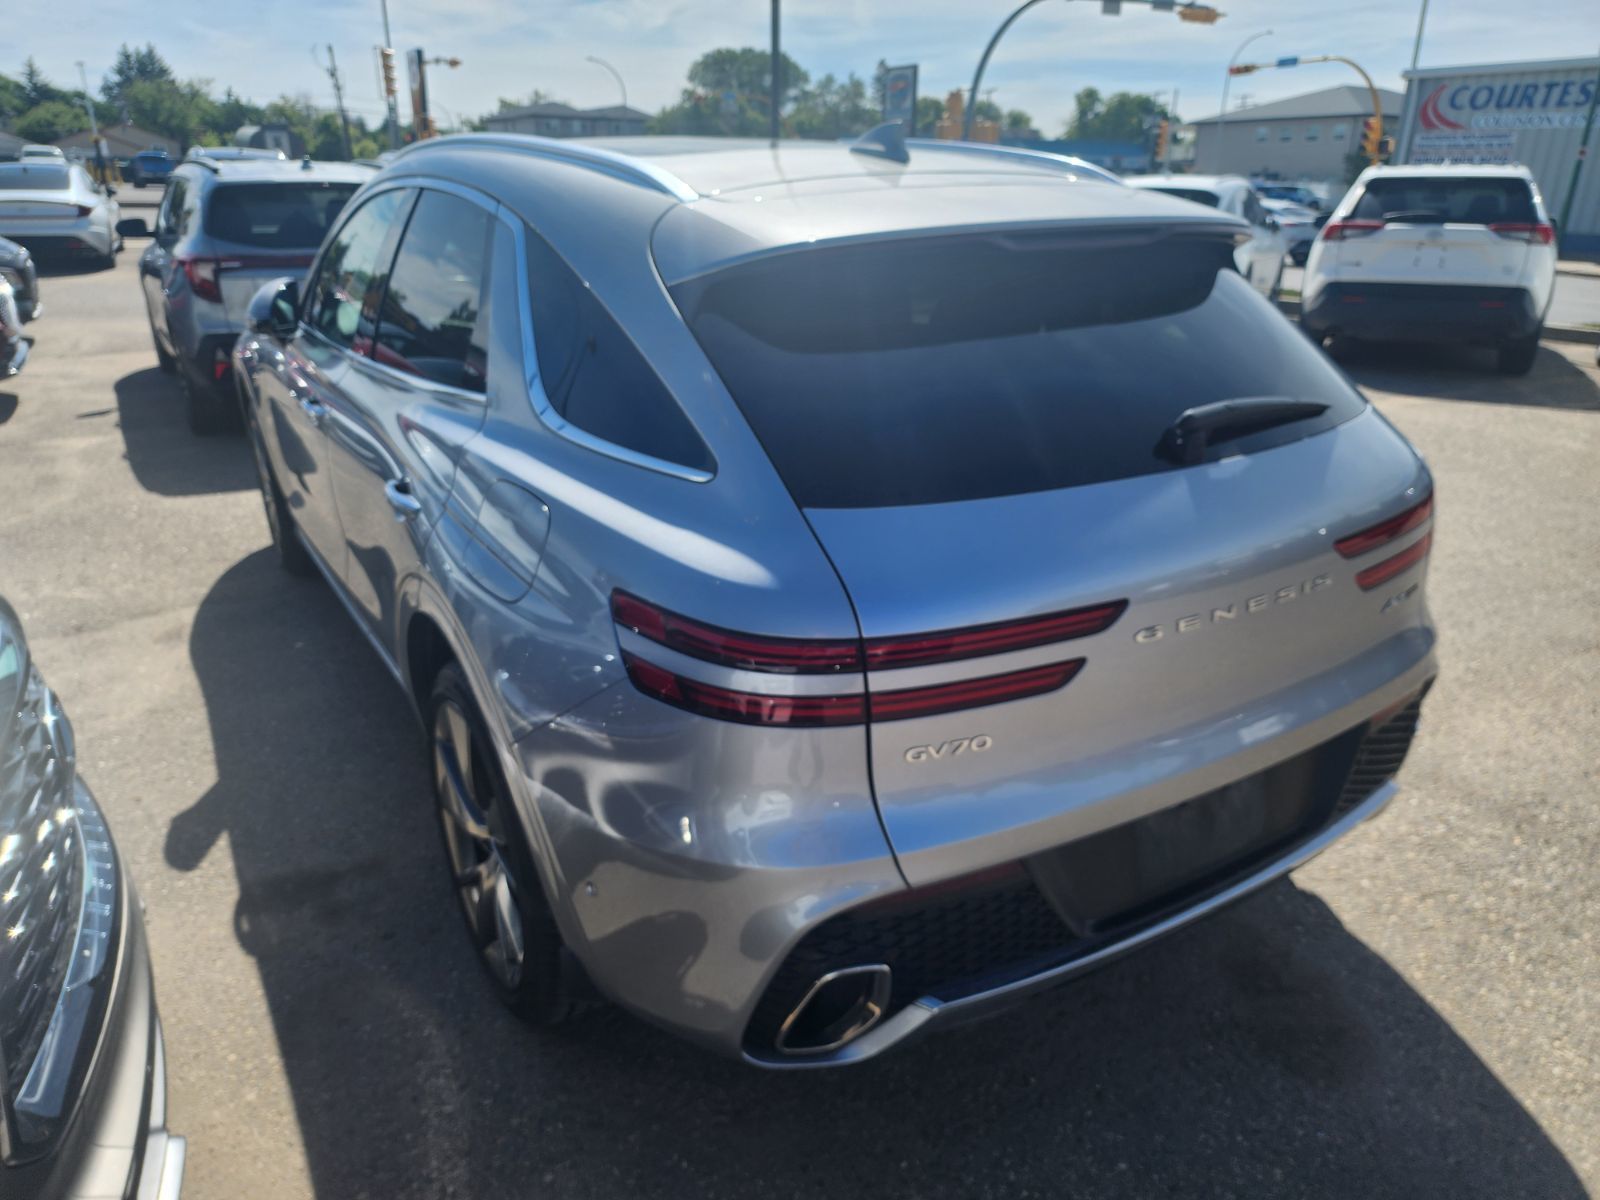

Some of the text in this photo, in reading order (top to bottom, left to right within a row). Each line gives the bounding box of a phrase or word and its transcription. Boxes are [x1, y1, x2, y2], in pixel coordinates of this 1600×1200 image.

[1449, 79, 1600, 111] COURTES
[1134, 573, 1333, 643] GENESIS
[904, 734, 993, 763] GV70
